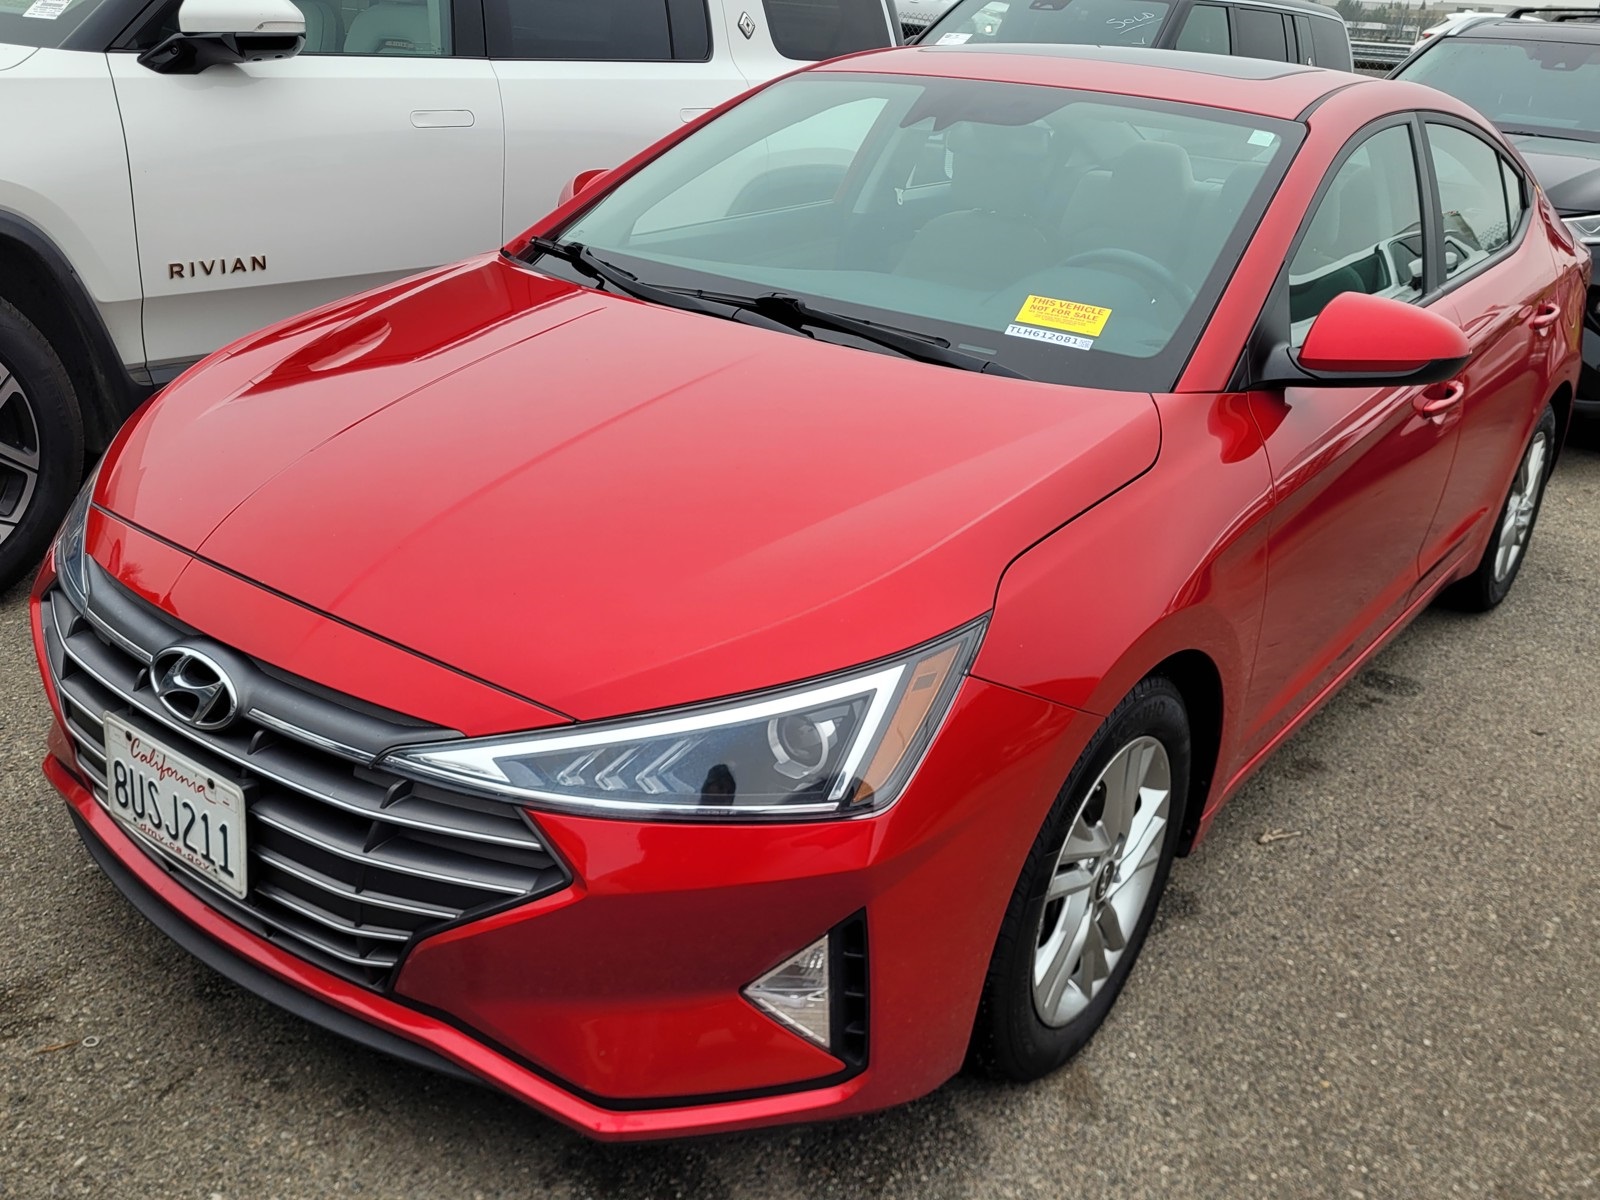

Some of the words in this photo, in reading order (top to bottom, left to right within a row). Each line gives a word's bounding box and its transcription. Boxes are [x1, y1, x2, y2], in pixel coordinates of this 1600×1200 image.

[168, 255, 267, 280] RIVIAN
[1029, 304, 1049, 313] NOT
[1051, 308, 1071, 317] FOR
[1073, 312, 1099, 321] SALE
[1032, 296, 1057, 307] THIS
[1060, 301, 1105, 316] VEHICLE
[1009, 326, 1078, 345] TLH612081
[130, 737, 216, 804] California
[114, 760, 235, 878] 8USJ211
[139, 821, 210, 871] dmv.ca.gov
